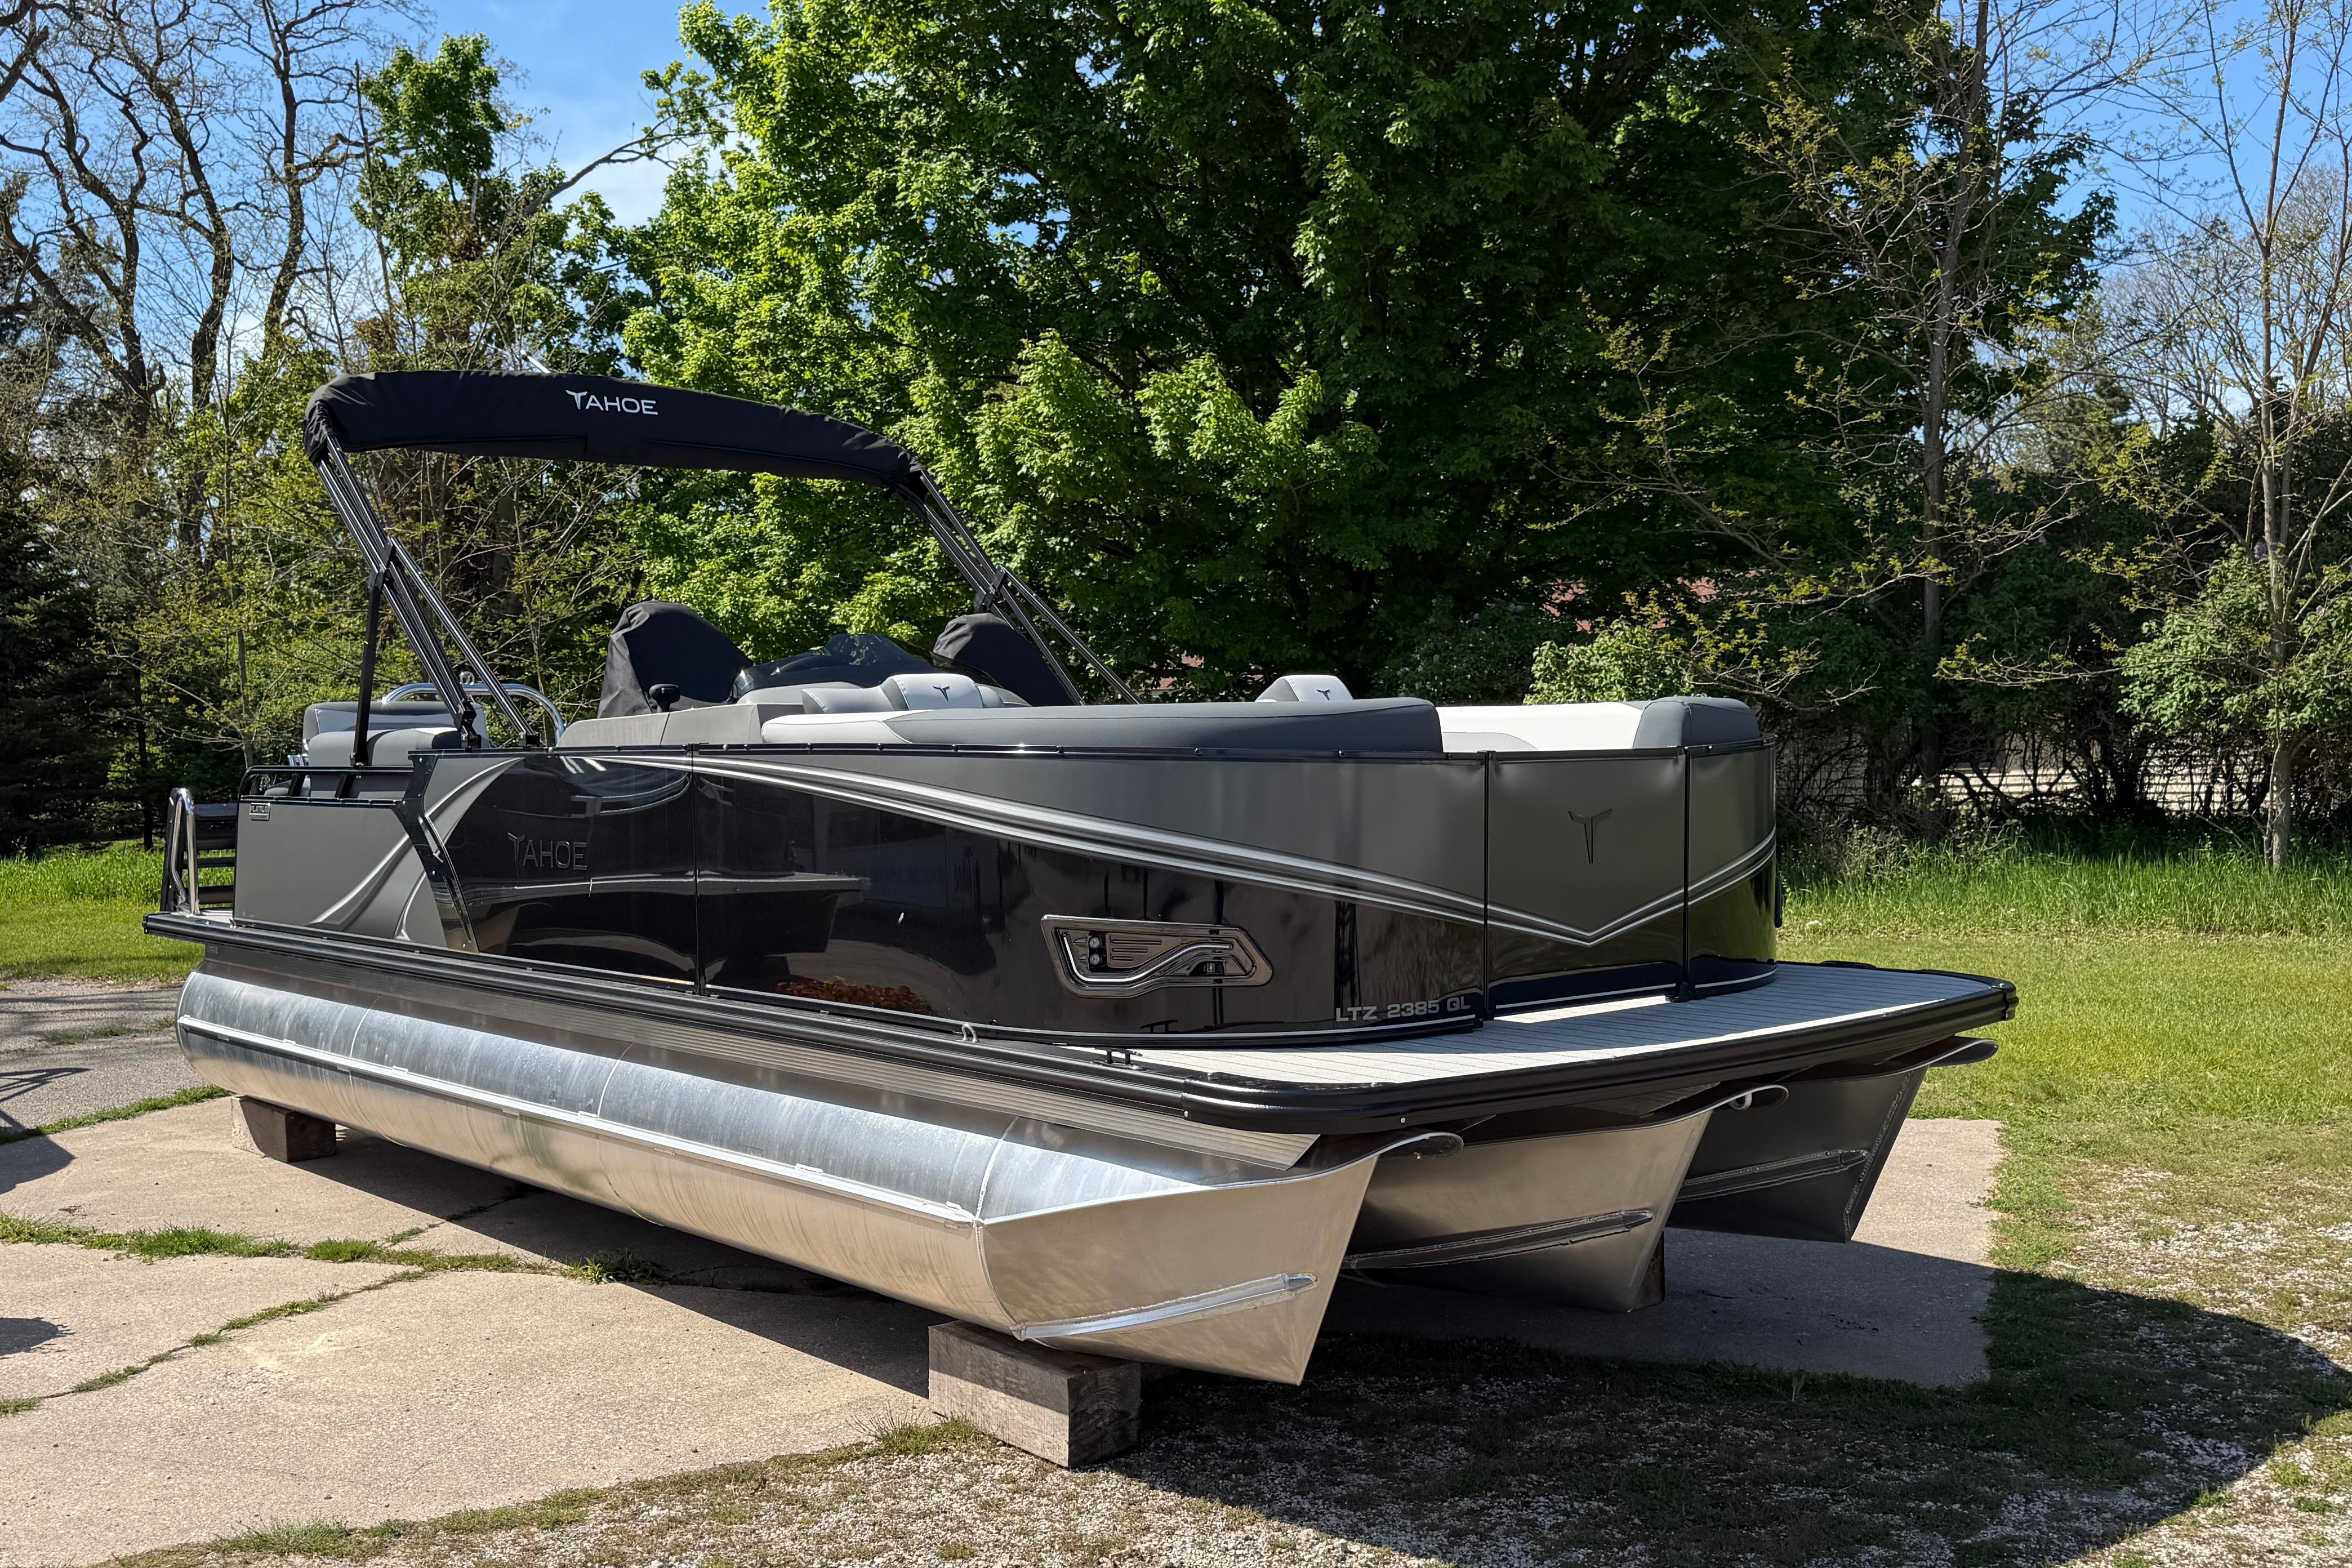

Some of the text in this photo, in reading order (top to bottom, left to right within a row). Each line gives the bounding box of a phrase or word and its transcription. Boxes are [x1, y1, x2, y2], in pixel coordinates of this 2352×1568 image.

[565, 390, 658, 415] TAHOE
[507, 832, 588, 879] TAHOE
[1335, 996, 1471, 1022] LTZ 2385 QL
